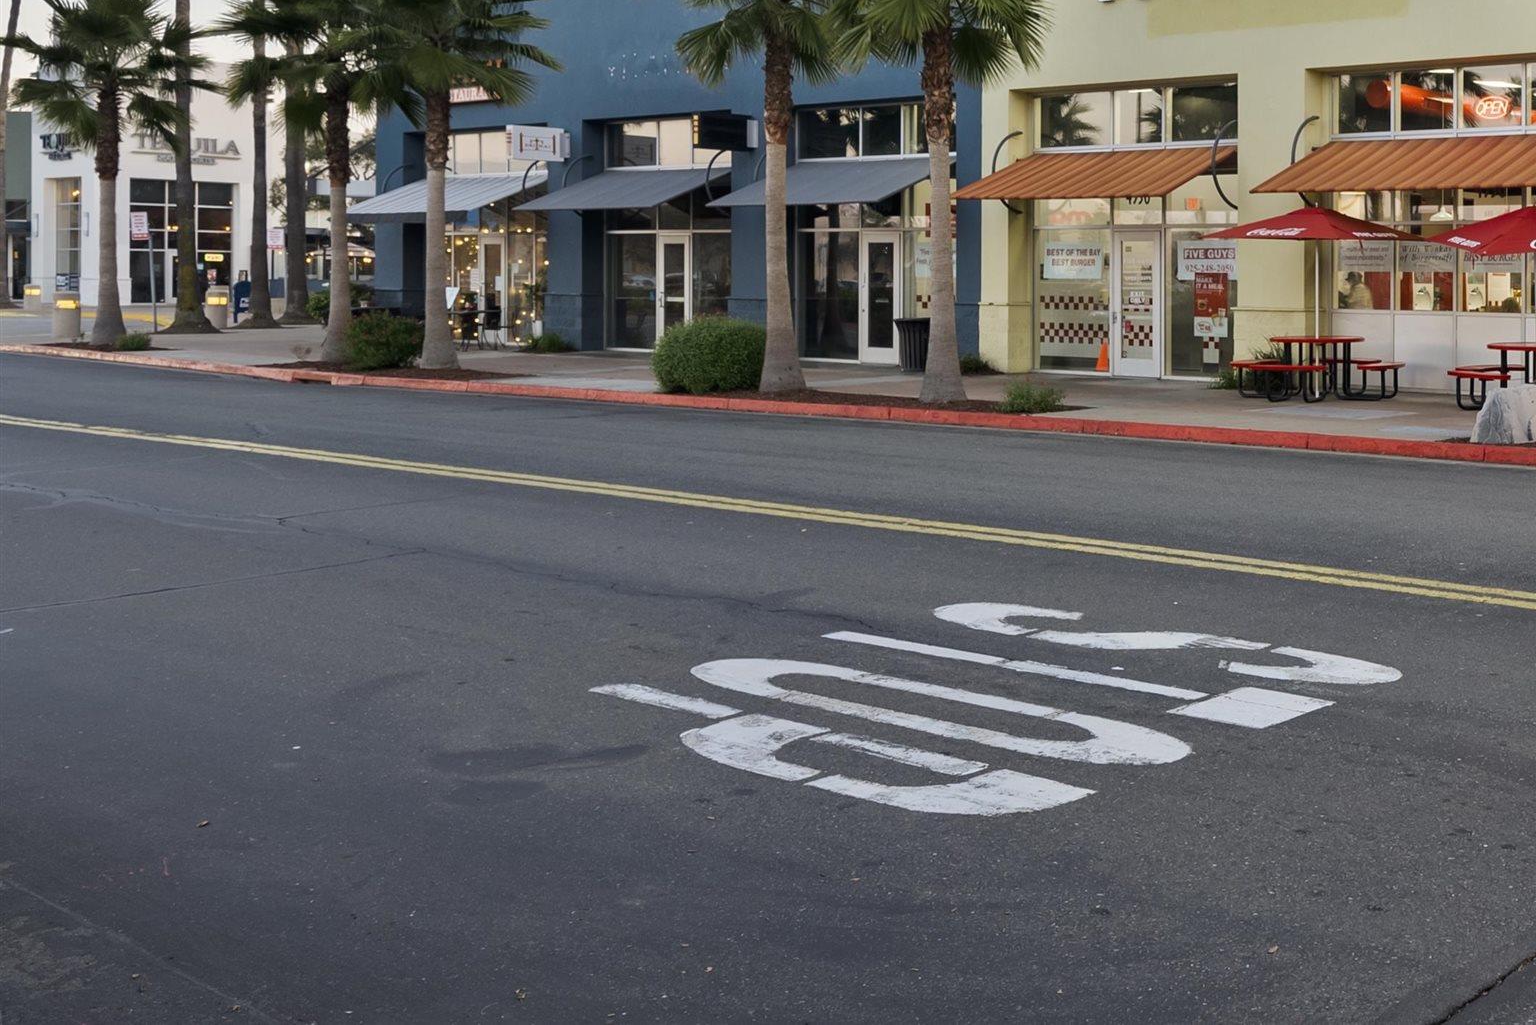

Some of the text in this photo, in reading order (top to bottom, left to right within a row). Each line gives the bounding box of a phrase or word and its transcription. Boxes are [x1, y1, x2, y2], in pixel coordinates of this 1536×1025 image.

[1477, 100, 1509, 115] OPEN
[131, 131, 241, 156] TEUILA
[1089, 248, 1101, 256] BAY
[1184, 249, 1235, 259] FIVE GUYS
[1052, 258, 1096, 266] BEST BURGER
[588, 601, 1403, 817] STOP
